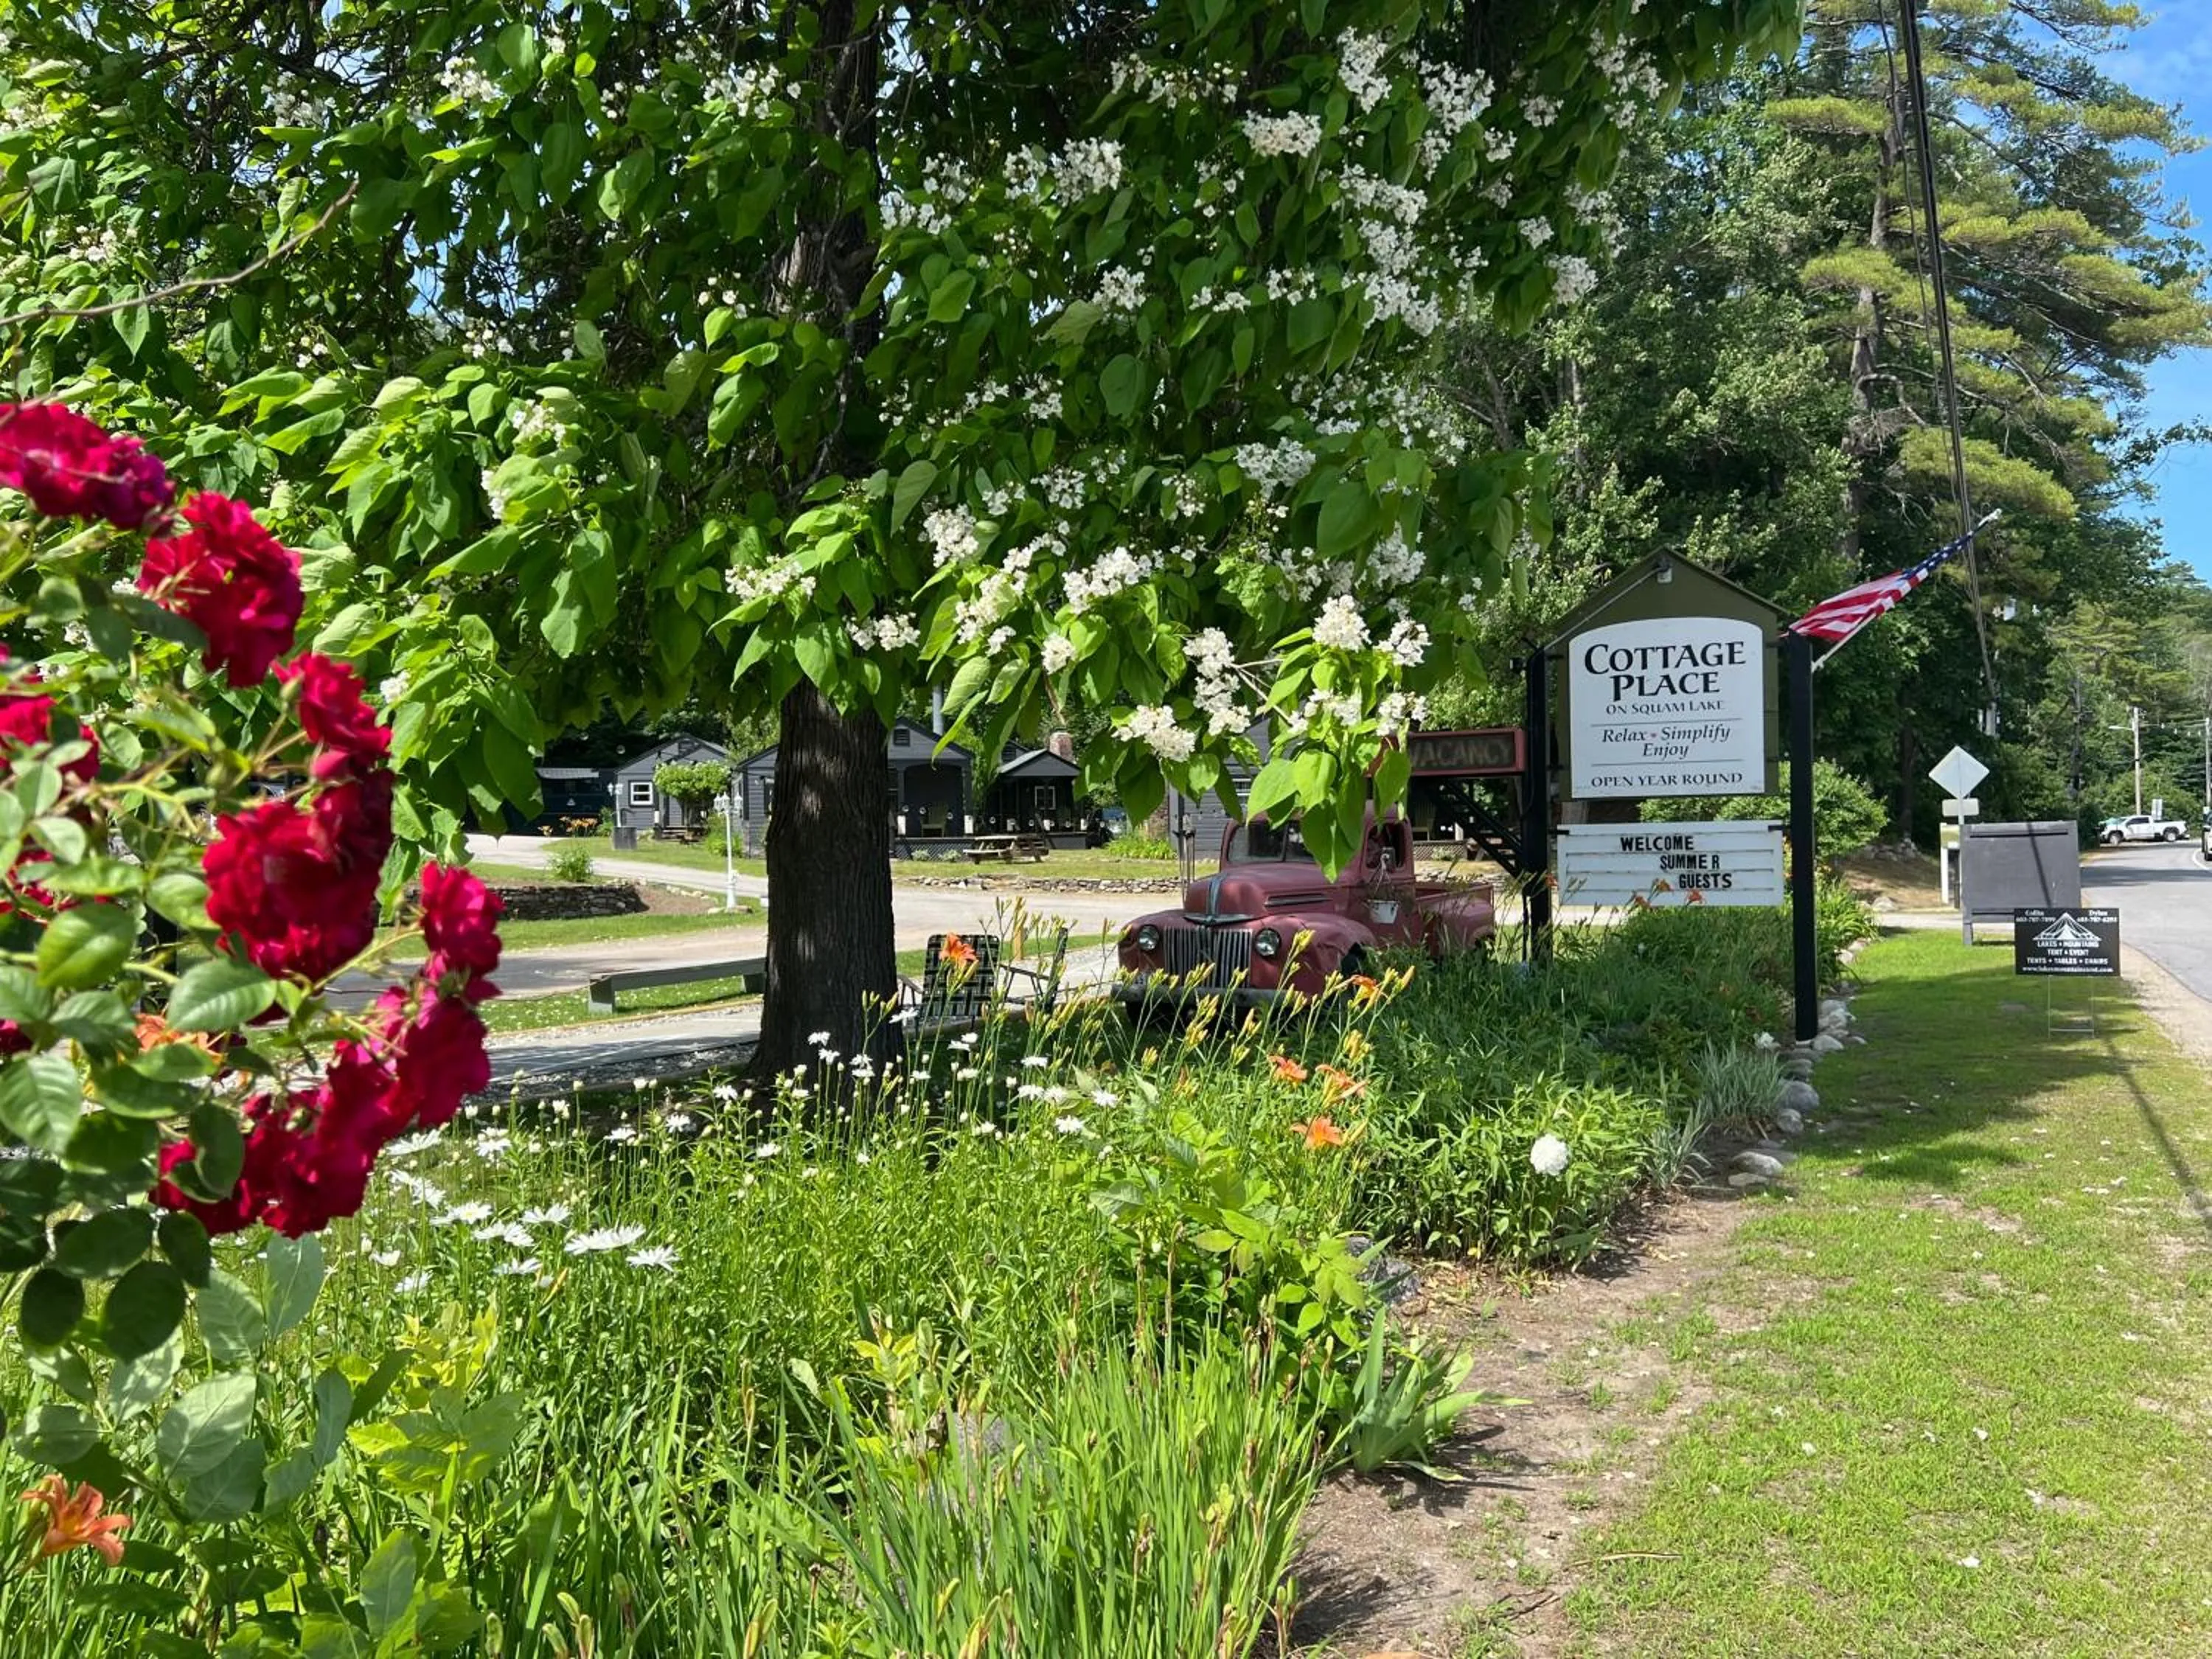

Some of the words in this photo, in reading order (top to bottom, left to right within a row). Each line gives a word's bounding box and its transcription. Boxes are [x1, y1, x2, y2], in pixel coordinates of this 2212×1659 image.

[1584, 641, 1746, 675] COTTAGE
[1610, 672, 1720, 702] PLACE
[1606, 706, 1628, 715] ON
[1631, 702, 1686, 716] SQUAM
[1688, 700, 1726, 712] LAKE
[1602, 727, 1648, 743] Relax
[1660, 723, 1731, 745] Simplify
[1642, 742, 1689, 761] Enjoy
[1591, 776, 1634, 788] OPEN
[1638, 774, 1678, 786] YEAR
[1682, 772, 1743, 785] ROUND
[1621, 835, 1694, 852] WELCOME
[1678, 873, 1732, 889] GUESTS
